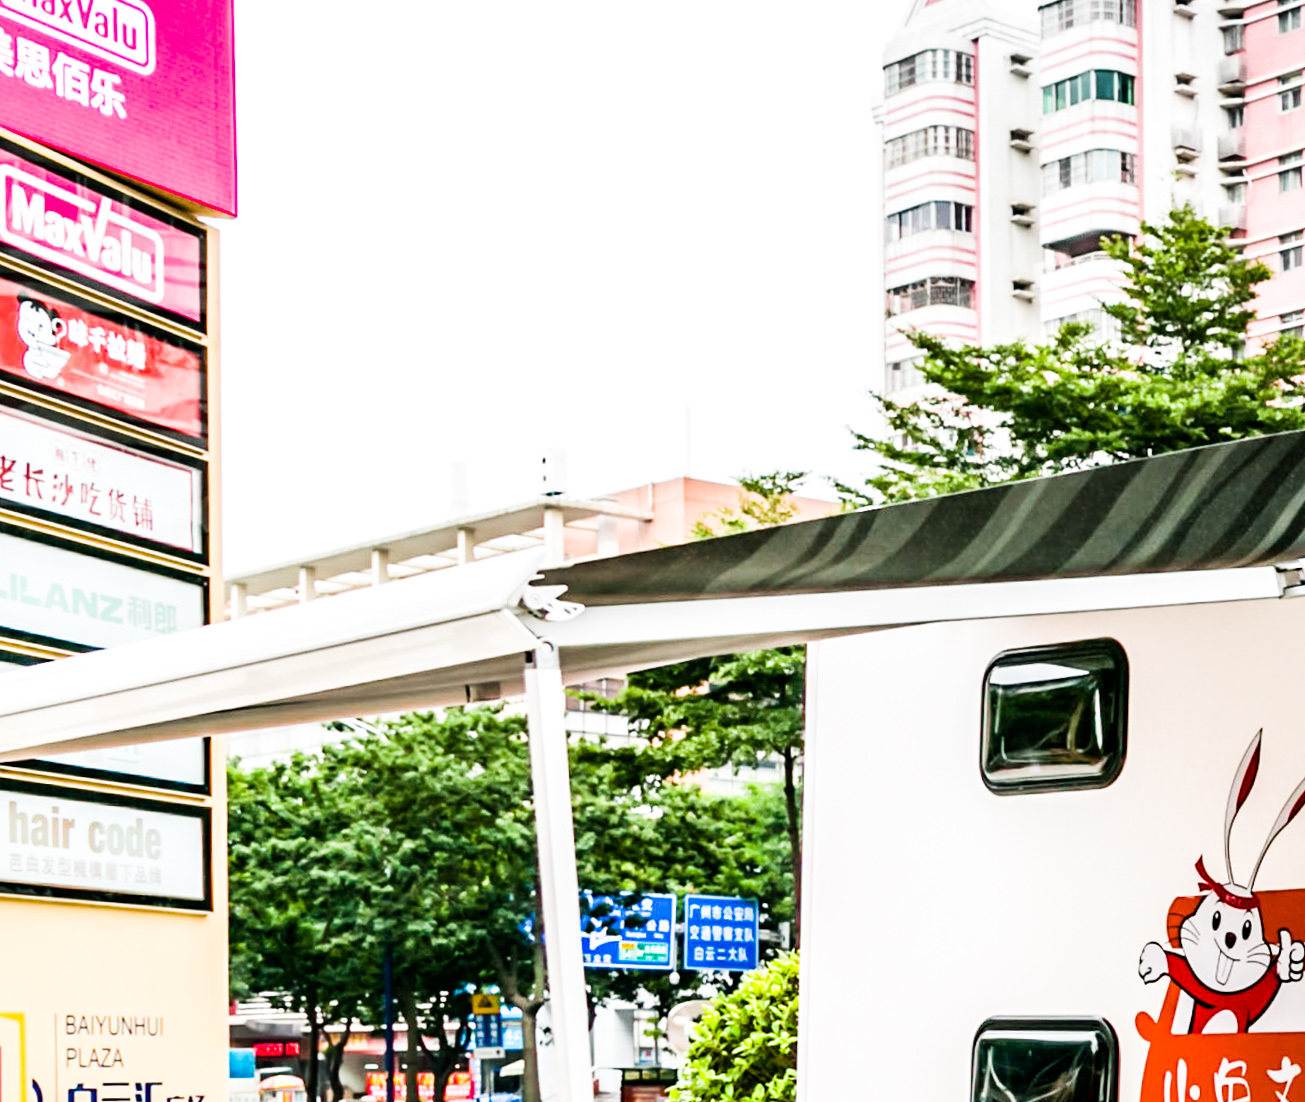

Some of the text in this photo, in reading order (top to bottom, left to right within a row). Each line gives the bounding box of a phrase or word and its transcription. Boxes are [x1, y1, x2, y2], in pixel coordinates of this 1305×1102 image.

[22, 0, 138, 51] axValu
[9, 183, 154, 288] MaxValu
[8, 800, 162, 861] hair code
[693, 946, 749, 963] 白云二大队
[65, 1014, 165, 1037] BAIYUNHUI
[66, 1047, 125, 1068] PLAZA
